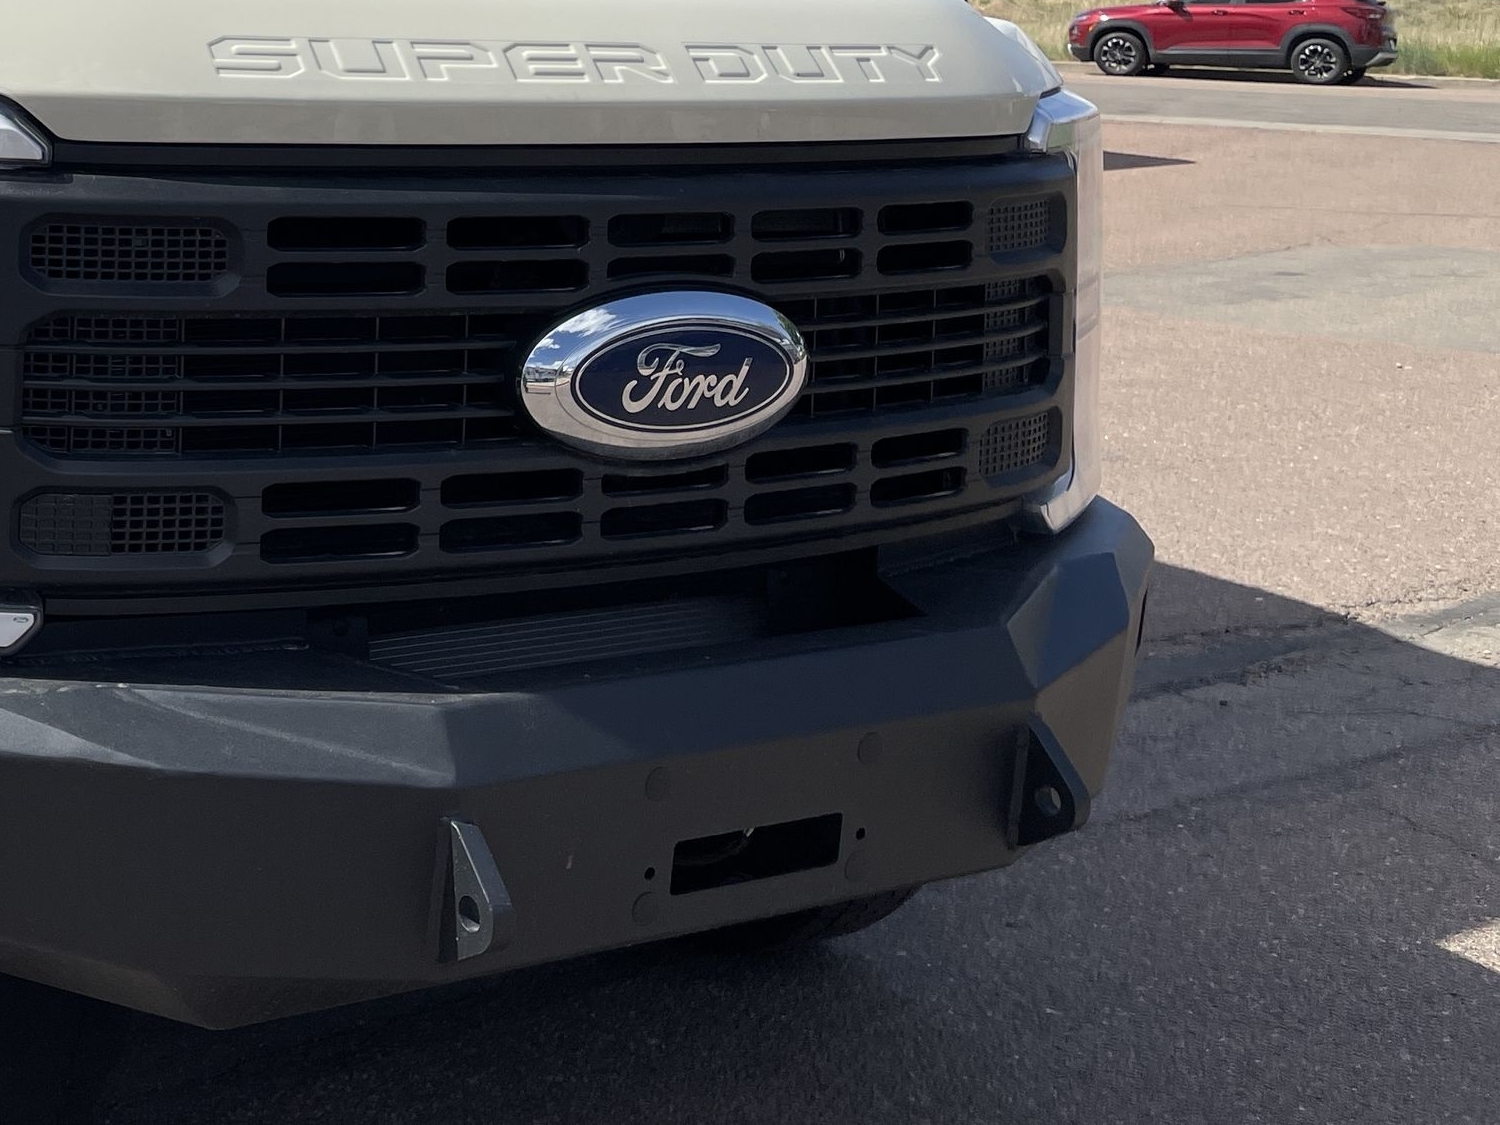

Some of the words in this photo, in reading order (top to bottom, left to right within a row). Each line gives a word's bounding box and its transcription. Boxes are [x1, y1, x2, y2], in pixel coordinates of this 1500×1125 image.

[206, 35, 675, 83] SUPER
[684, 44, 942, 83] DUTY
[621, 342, 753, 414] Ford
